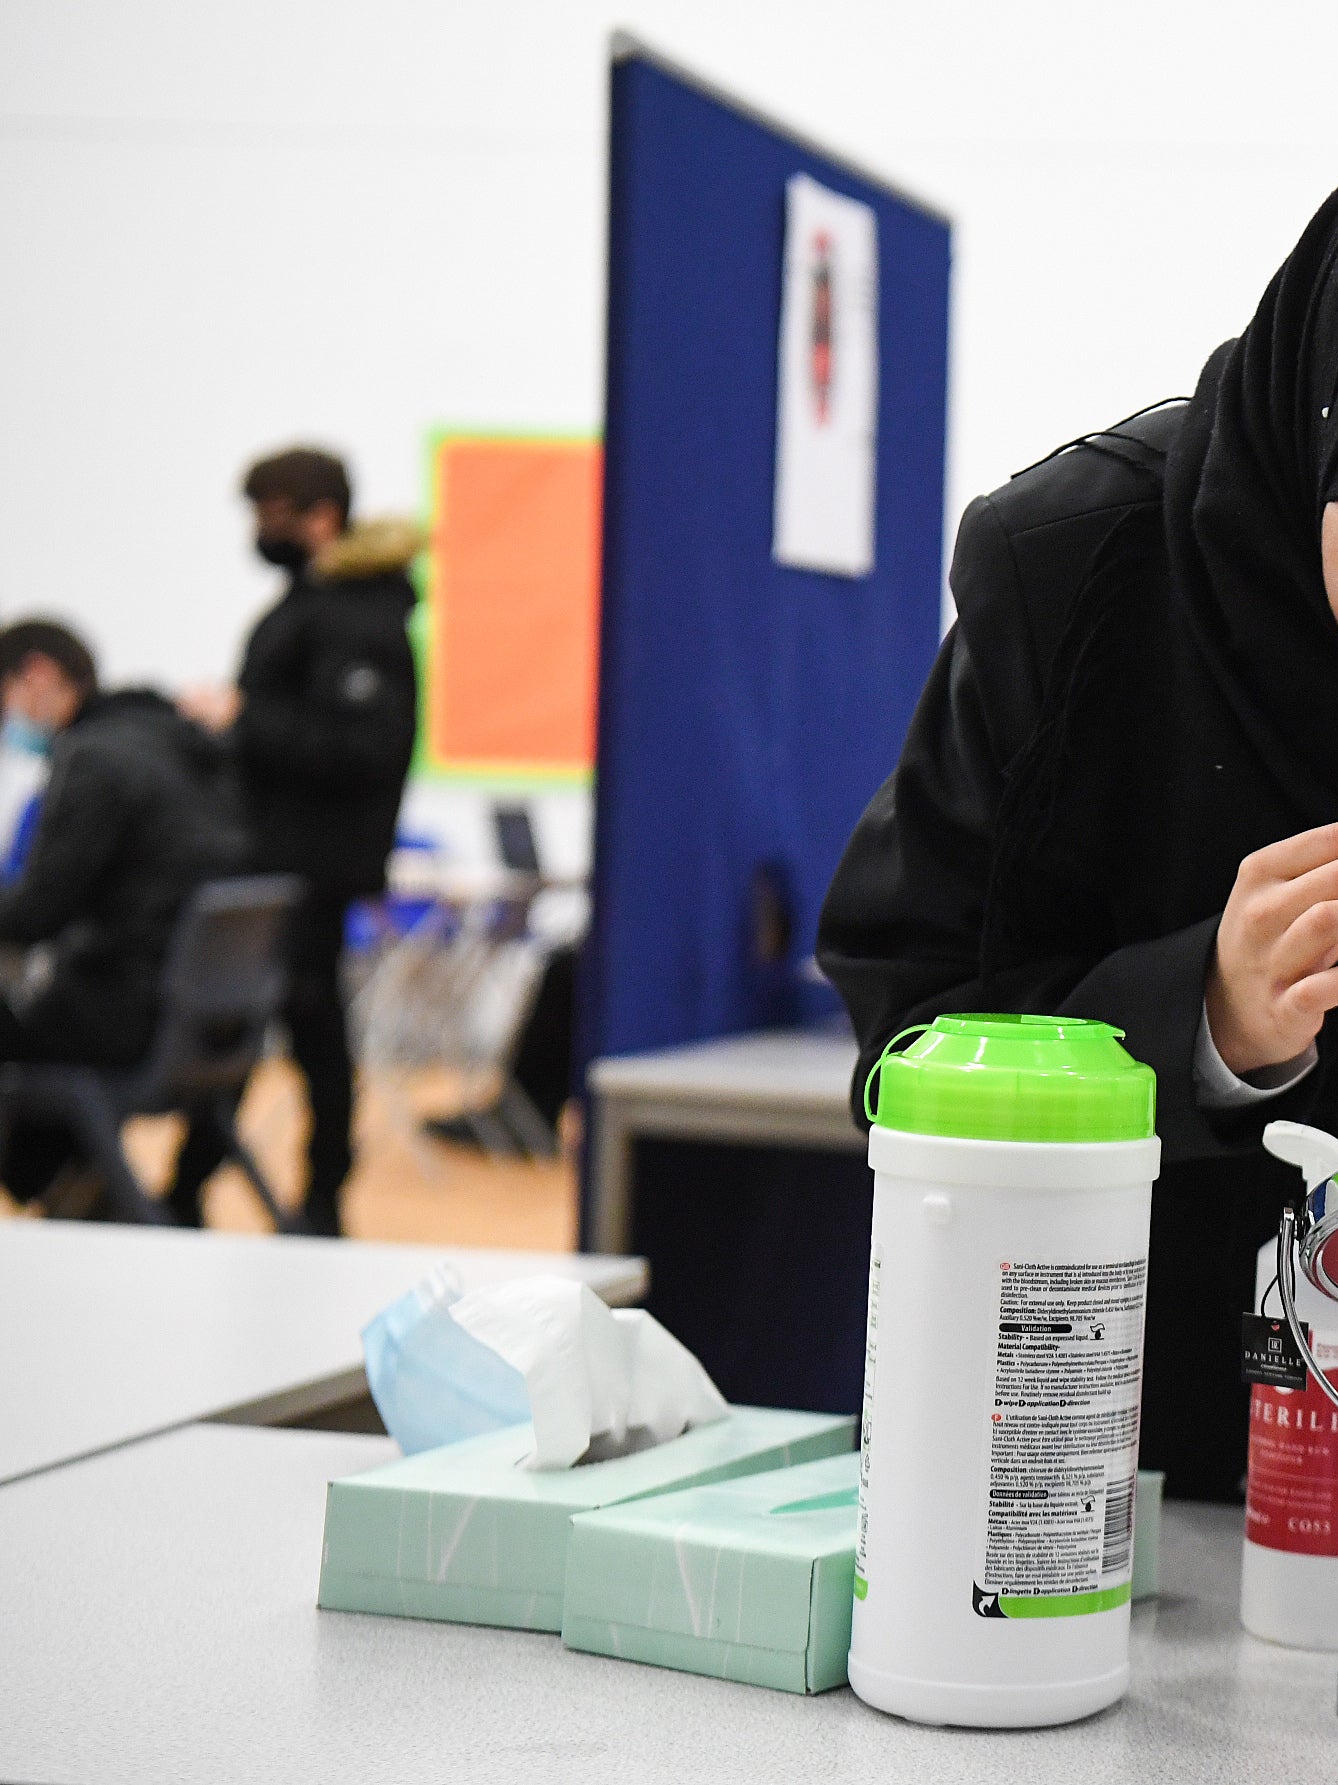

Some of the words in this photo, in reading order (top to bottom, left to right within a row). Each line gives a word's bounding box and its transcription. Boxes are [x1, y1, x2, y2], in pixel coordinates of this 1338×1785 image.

[1000, 1306, 1036, 1315] Composition:
[1021, 1324, 1052, 1332] Validation
[998, 1342, 1021, 1350] Material
[1244, 1350, 1301, 1367] DANIELLE
